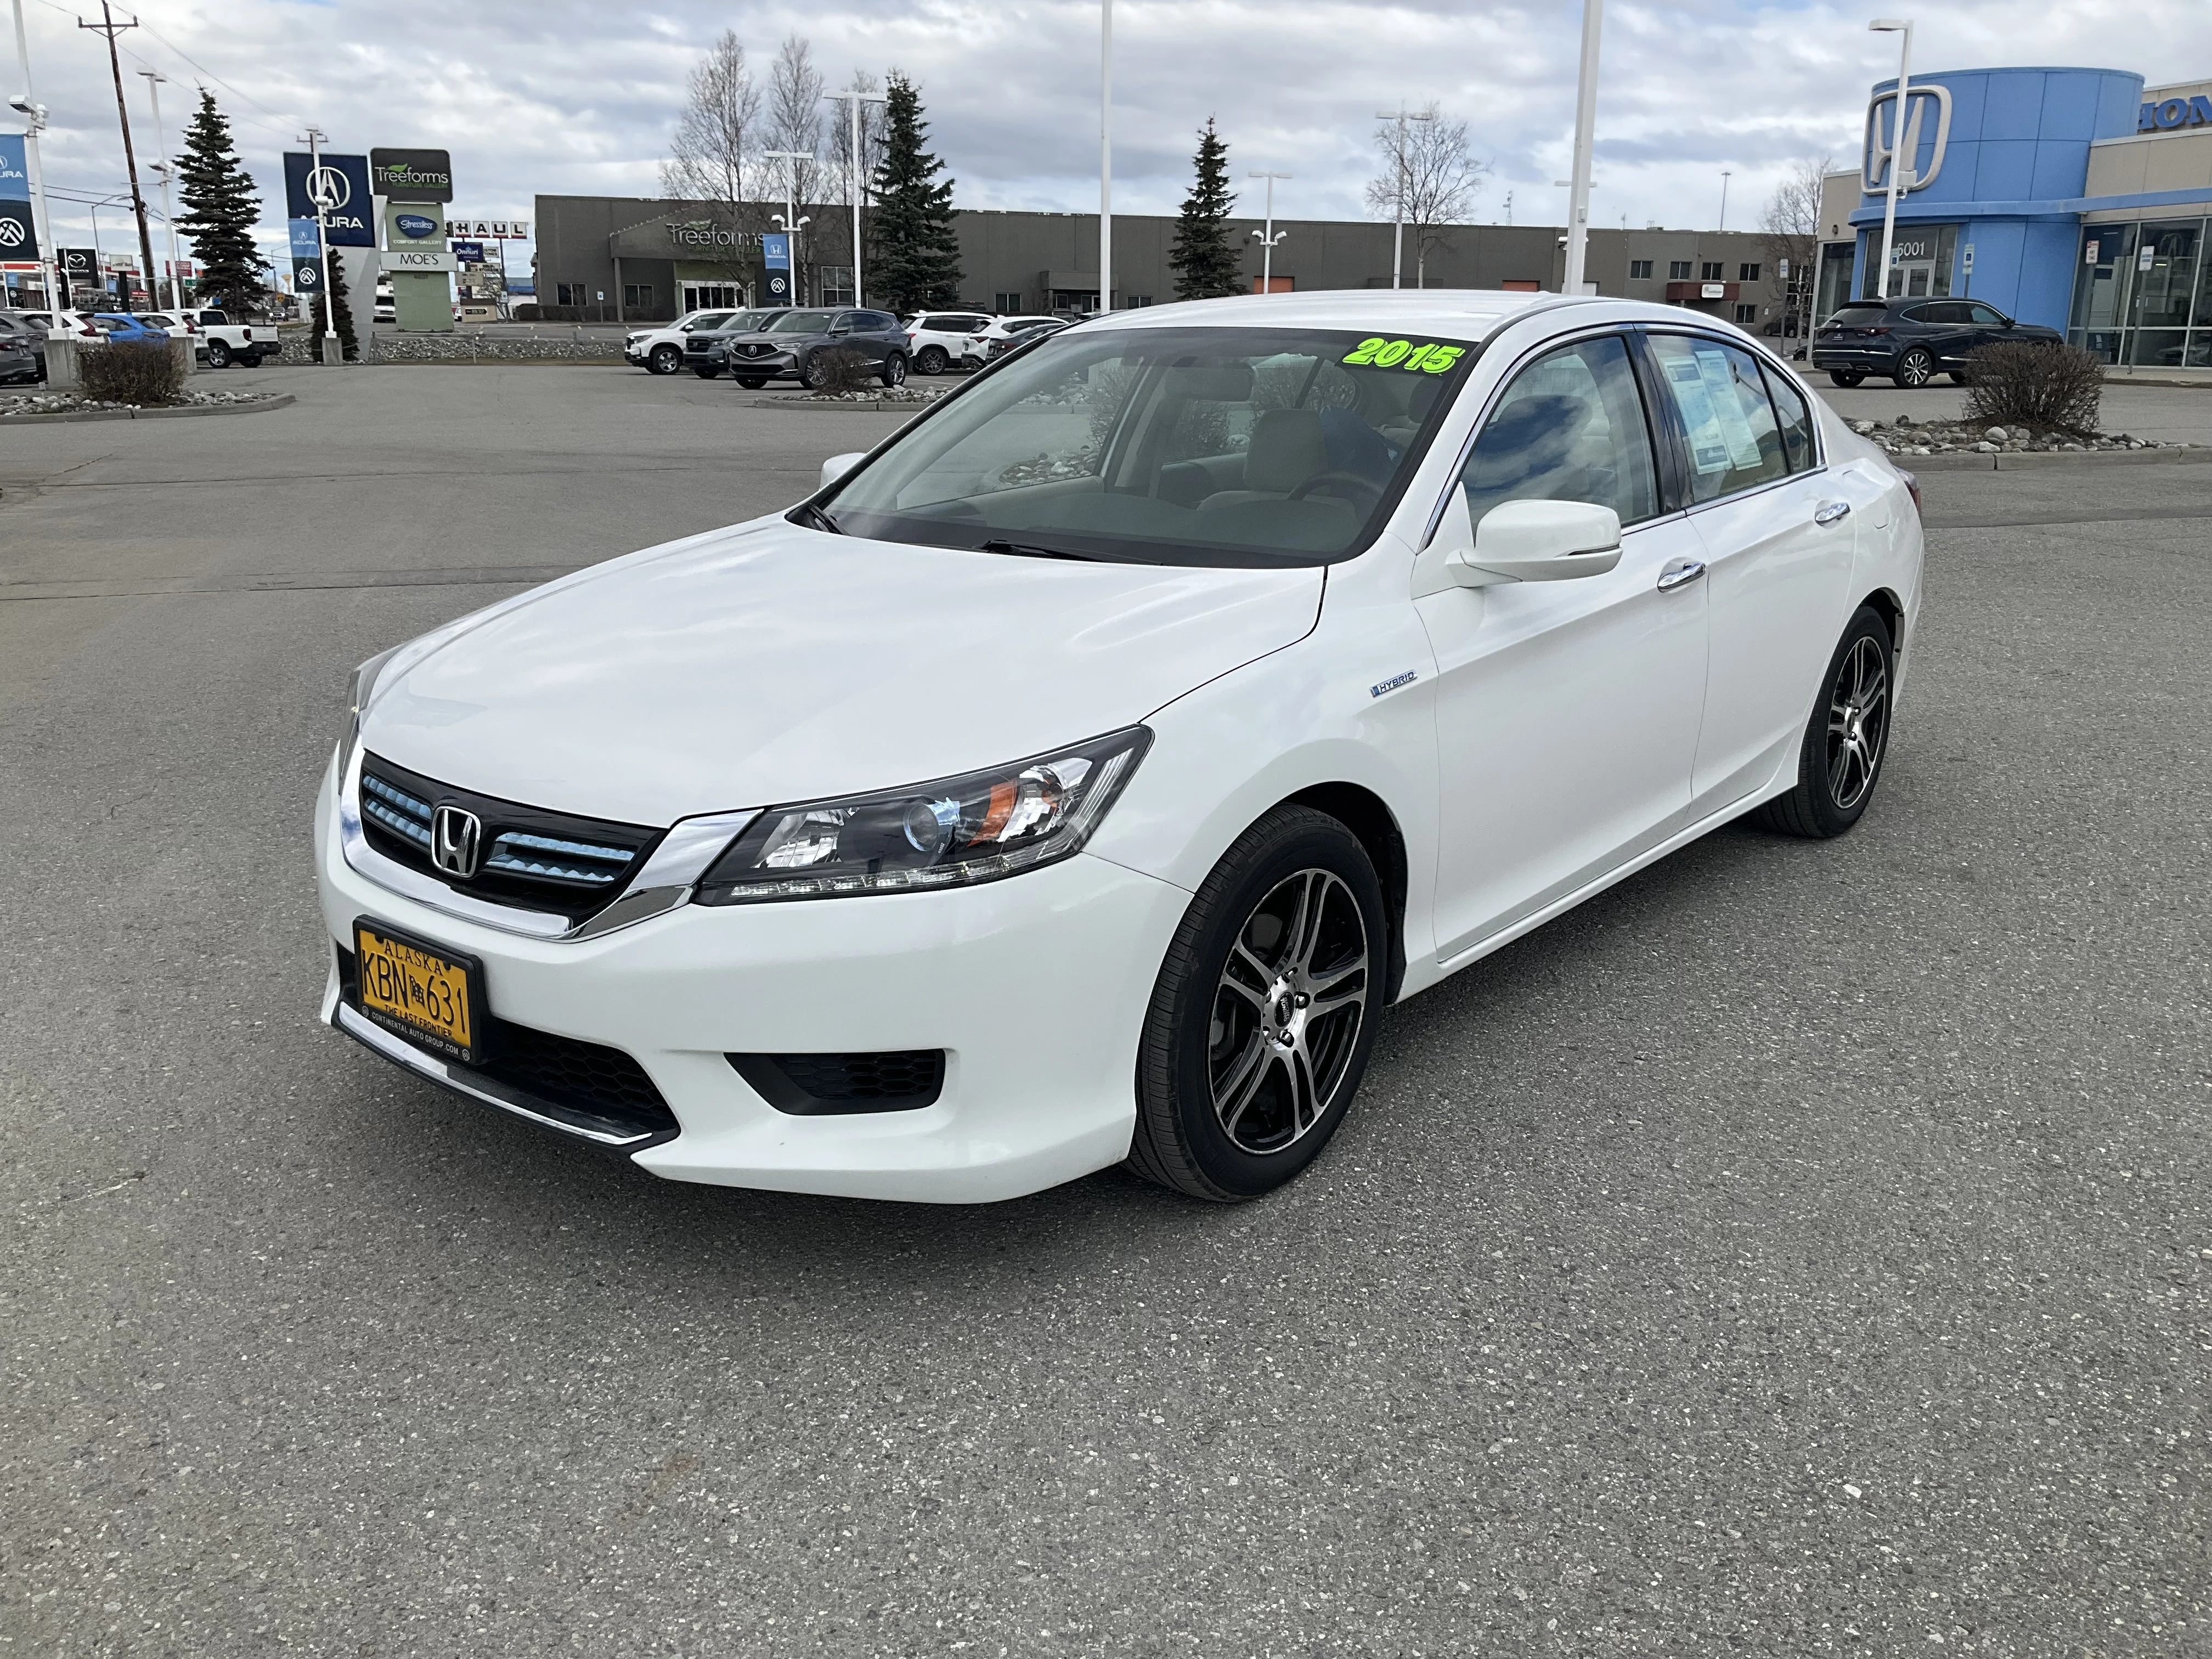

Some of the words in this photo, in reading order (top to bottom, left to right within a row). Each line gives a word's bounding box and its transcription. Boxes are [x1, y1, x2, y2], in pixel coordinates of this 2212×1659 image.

[375, 167, 448, 183] Treeforms
[301, 215, 364, 228] URA
[400, 219, 433, 229] Stressless
[1898, 241, 1925, 257] 5001
[400, 254, 438, 265] MOE'S
[1342, 337, 1466, 374] 2015
[1380, 672, 1414, 692] HYBRID
[384, 939, 443, 977] ALASKA
[362, 949, 409, 1009] KBN
[427, 975, 466, 1034] 631
[372, 1012, 408, 1033] CONTINENTAL
[409, 1028, 424, 1040] AUTO
[385, 1004, 398, 1016] THE
[400, 1009, 417, 1024] LAST
[419, 1018, 453, 1039] FRONTIER
